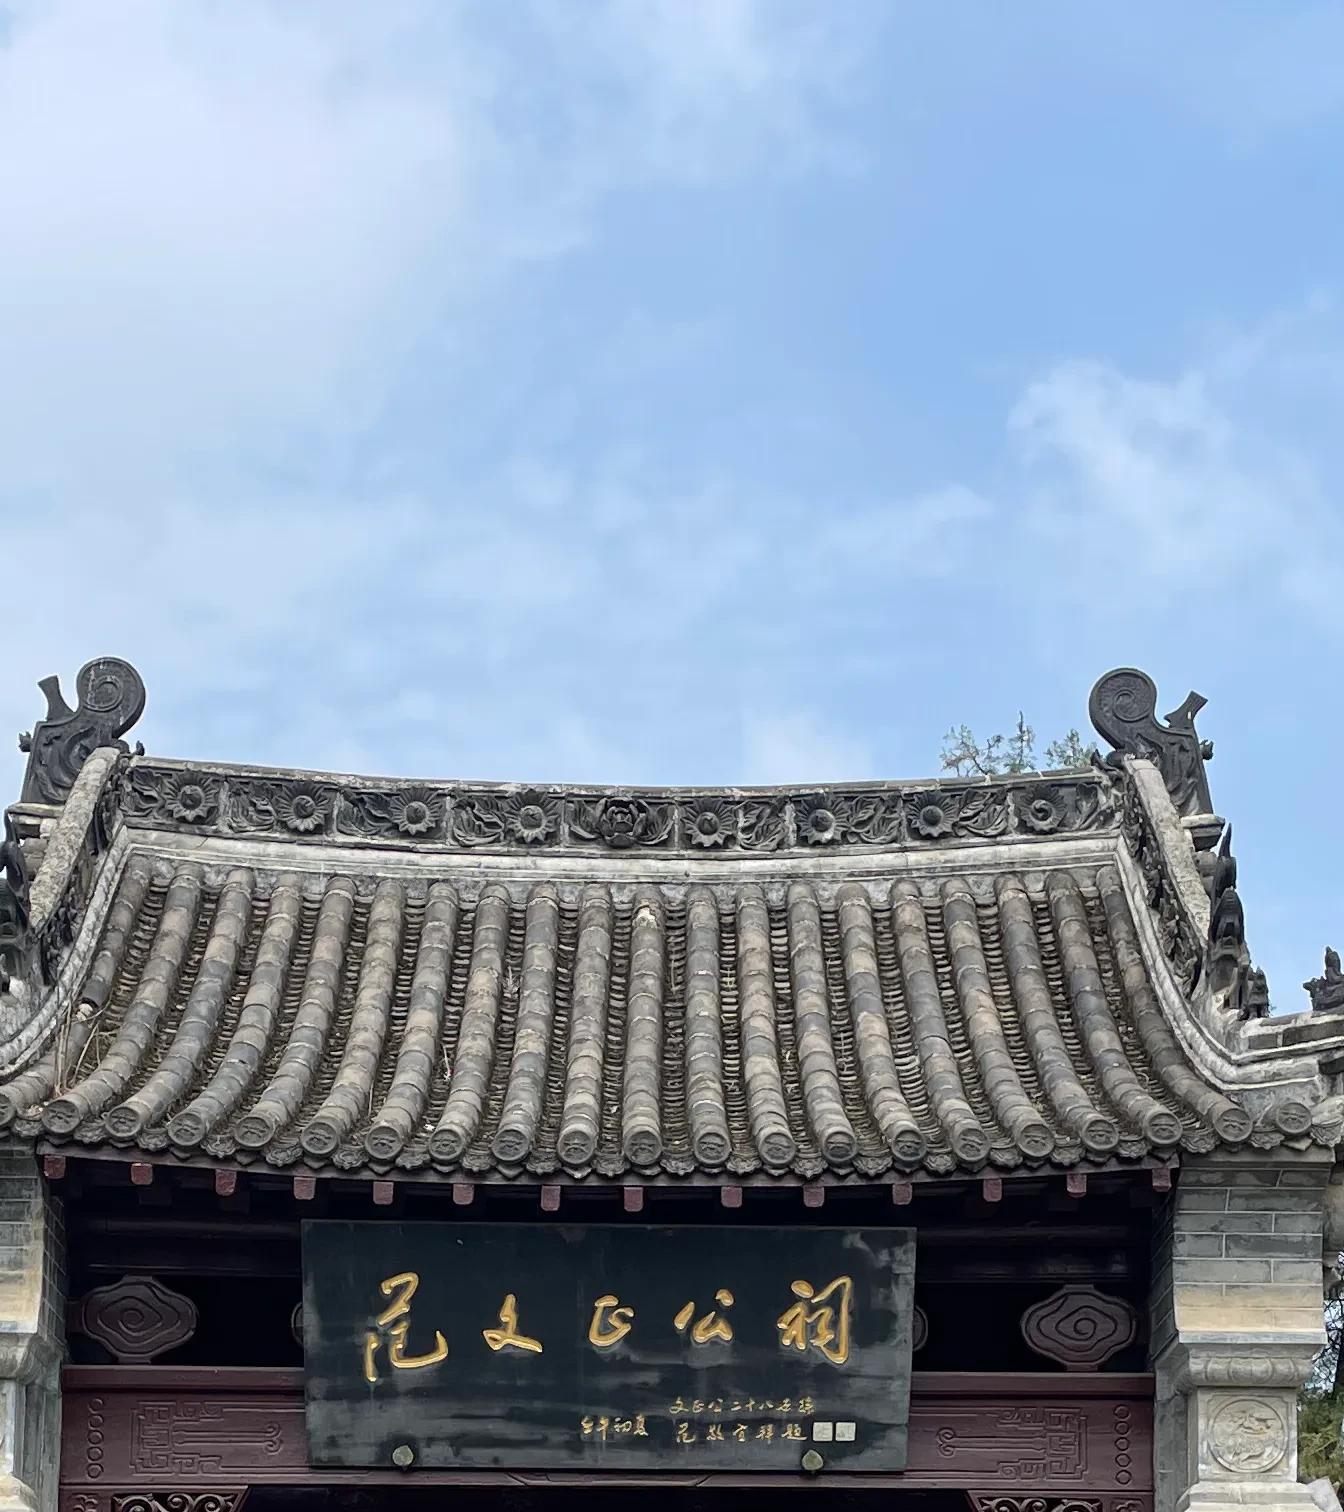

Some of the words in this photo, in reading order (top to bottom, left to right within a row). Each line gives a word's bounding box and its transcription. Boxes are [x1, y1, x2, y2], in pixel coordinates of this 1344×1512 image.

[364, 1272, 852, 1383] 范文正公祠
